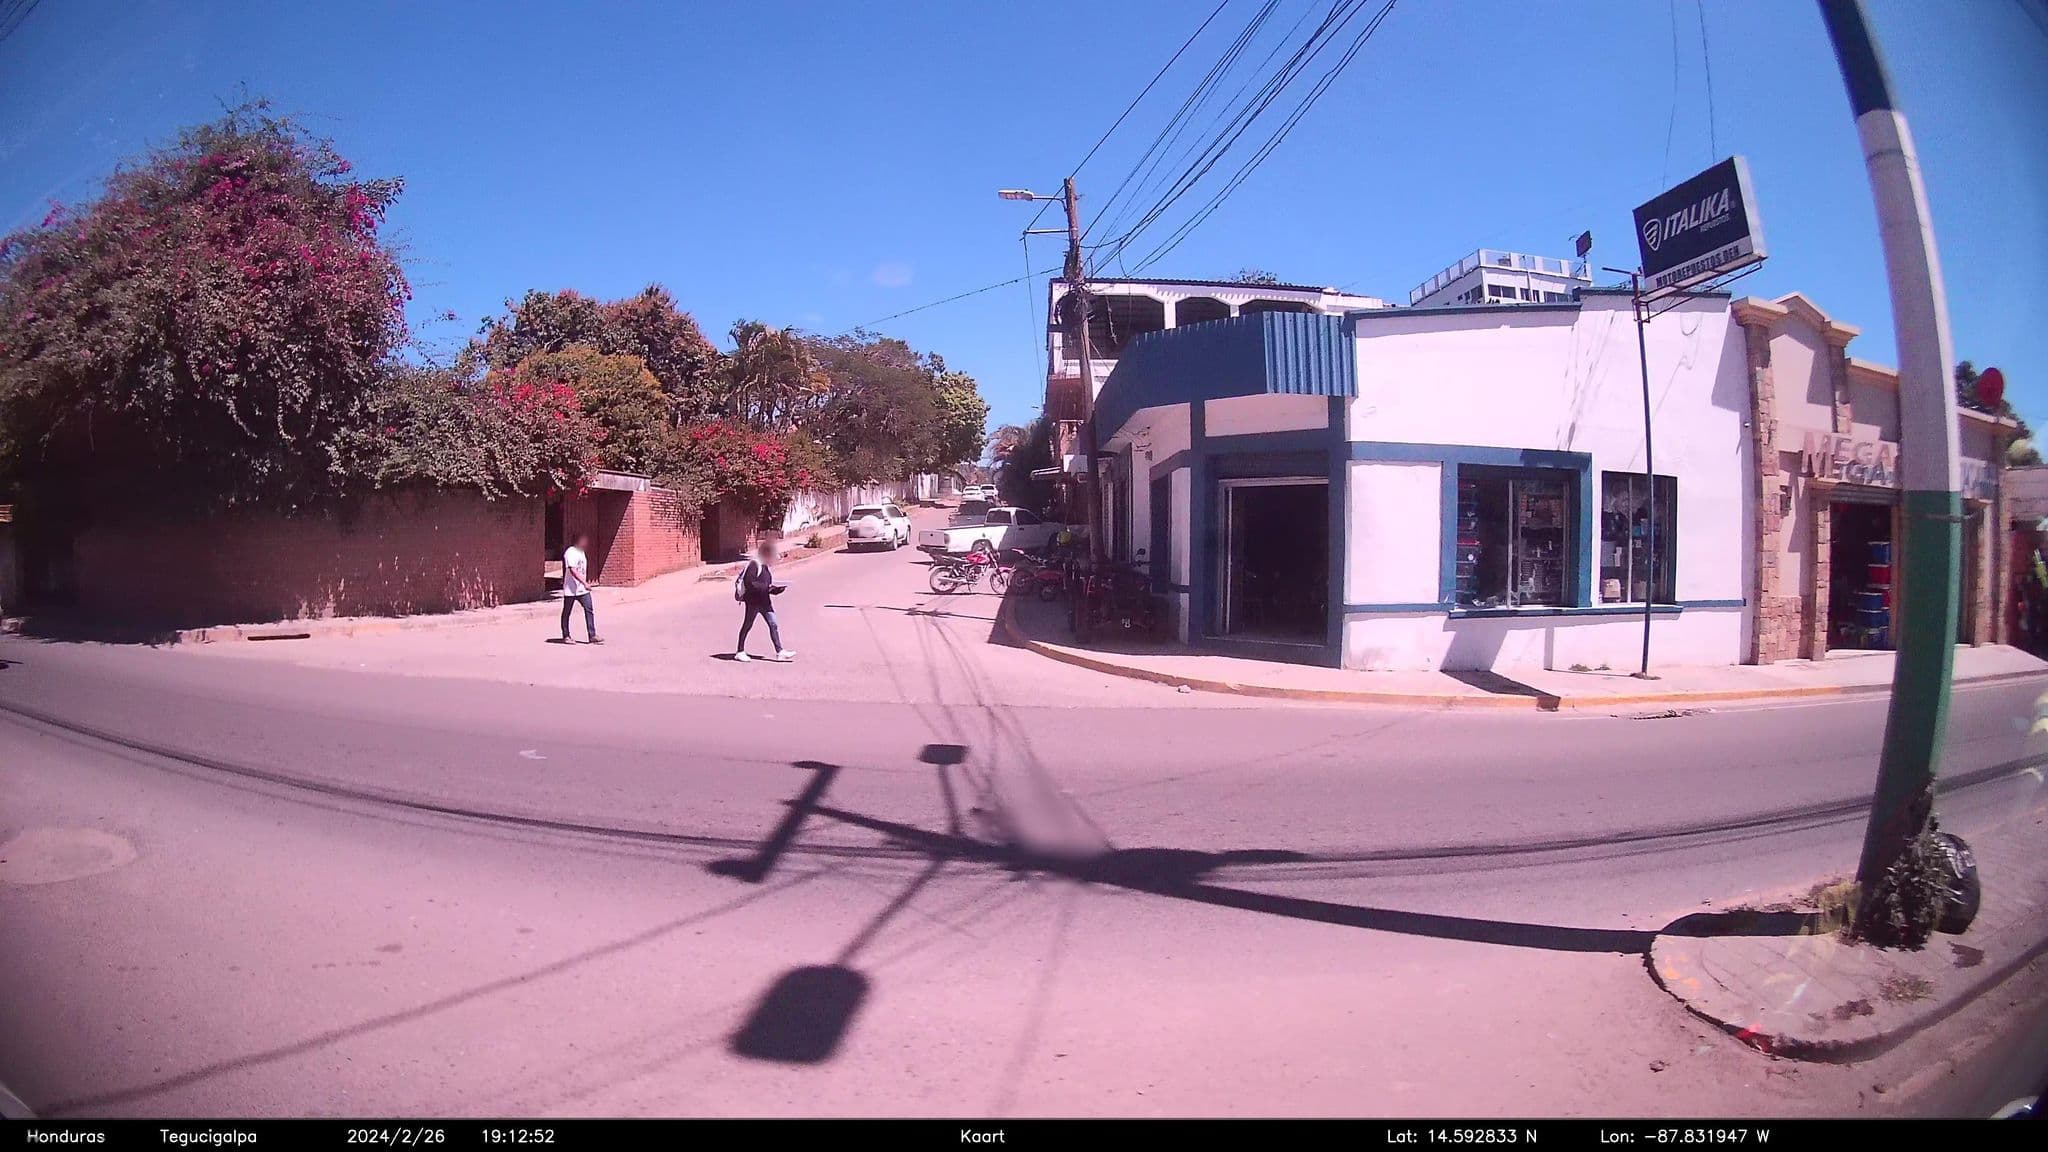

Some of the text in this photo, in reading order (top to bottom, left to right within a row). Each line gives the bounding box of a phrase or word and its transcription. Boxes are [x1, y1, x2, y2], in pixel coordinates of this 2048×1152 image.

[1663, 188, 1729, 241] ITALIKA
[1656, 253, 1721, 287] MOTOREPUESTOS
[1801, 432, 1896, 474] MEGA
